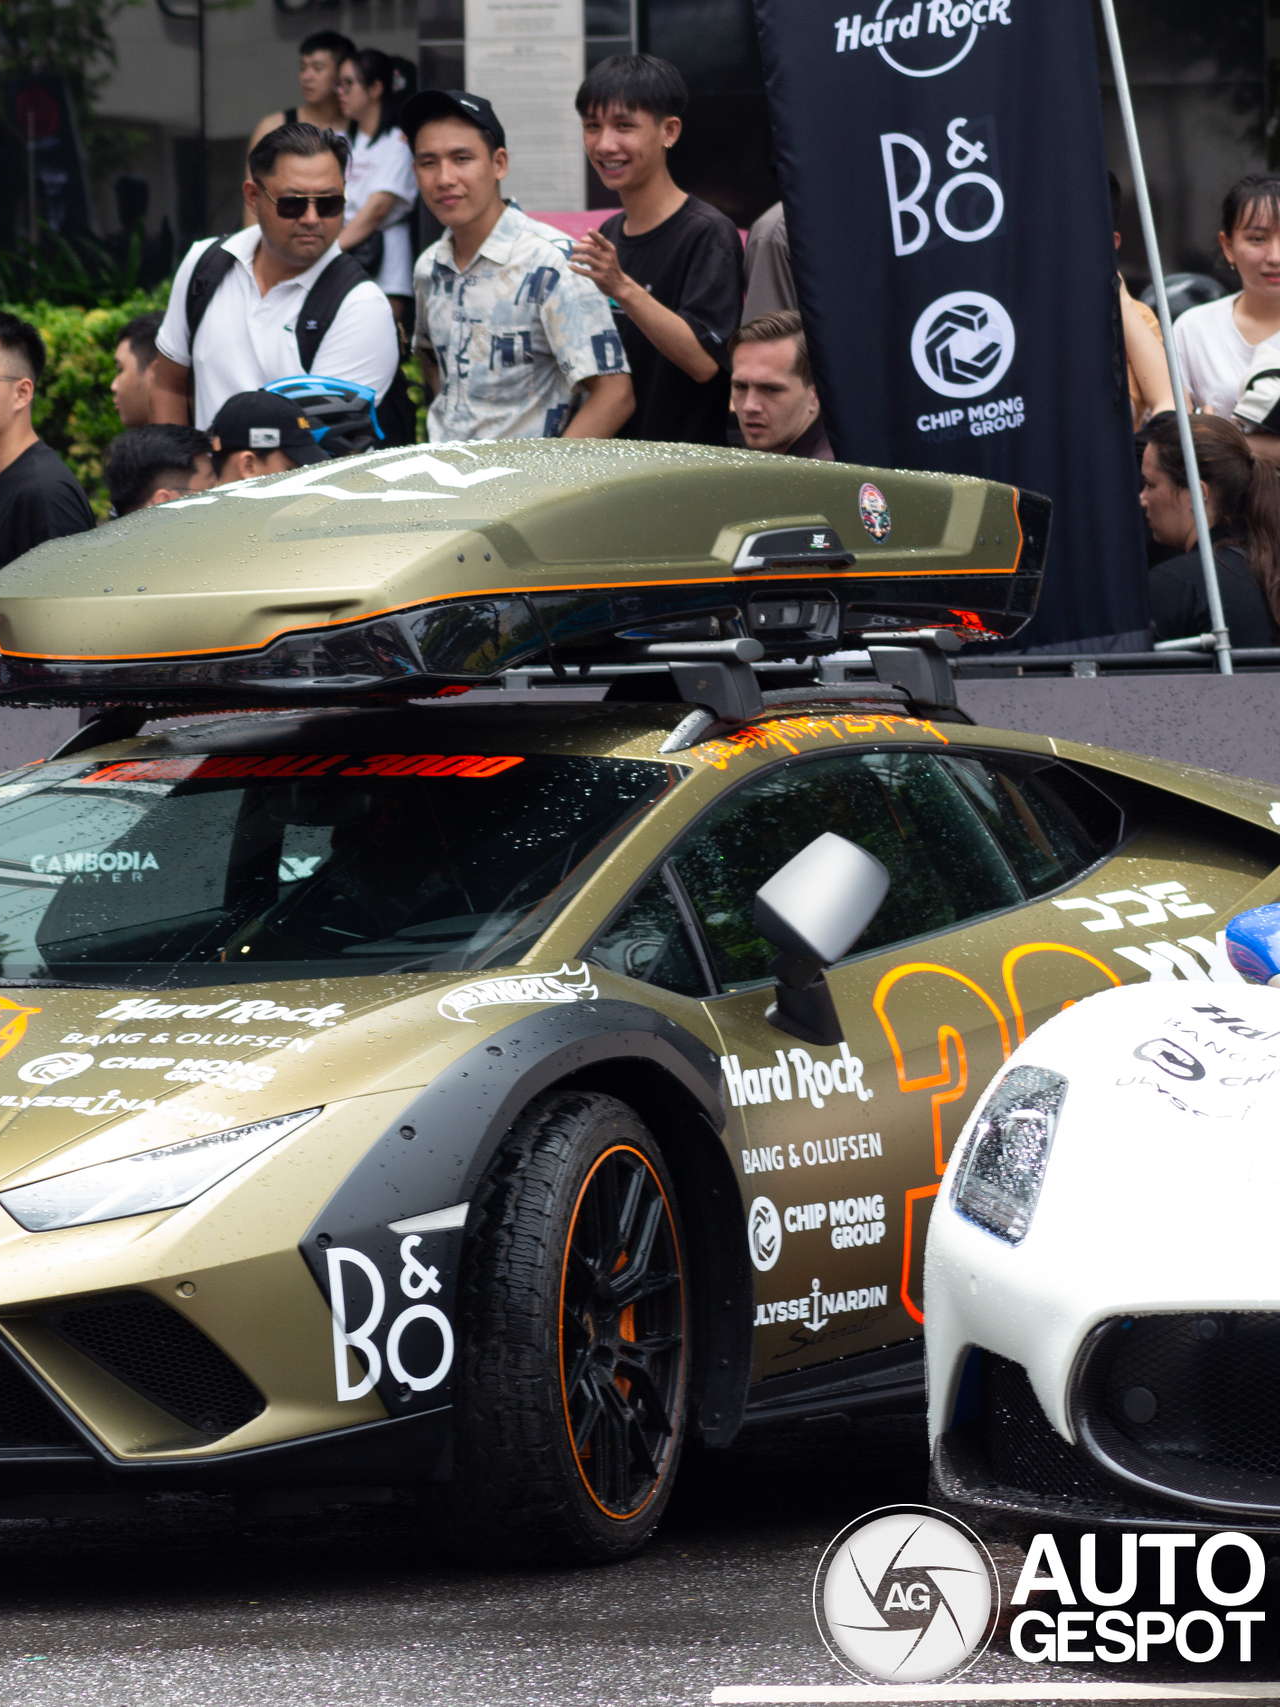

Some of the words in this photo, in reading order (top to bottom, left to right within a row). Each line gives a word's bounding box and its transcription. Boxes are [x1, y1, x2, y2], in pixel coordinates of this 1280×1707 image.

[834, 3, 922, 53] Hard
[926, 0, 1012, 38] Rock
[916, 409, 965, 432] CHIP
[967, 396, 1024, 422] MONG
[970, 412, 1025, 437] GROUP
[81, 754, 347, 785] GUMBALL
[339, 754, 526, 778] 3000
[30, 852, 160, 875] CAMBODIA
[48, 872, 144, 885] WATER
[95, 999, 231, 1021] Hard
[218, 999, 345, 1027] Rock
[60, 1032, 147, 1045] BANG
[149, 1033, 169, 1044] &
[175, 1033, 315, 1053] OLUFSEN
[98, 1056, 176, 1070] CHIP
[173, 1057, 277, 1083] MONG
[163, 1070, 264, 1093] GROUP
[720, 1050, 792, 1106] Hard
[788, 1042, 871, 1109] Rock
[108, 1097, 237, 1128] NARDIN
[742, 1145, 785, 1174] BANG
[788, 1143, 801, 1168] &
[803, 1132, 882, 1166] OLUFSEN
[784, 1203, 827, 1233] CHIP
[829, 1194, 886, 1226] MONG
[831, 1221, 886, 1249] GROUP
[821, 1285, 888, 1315] NARDIN
